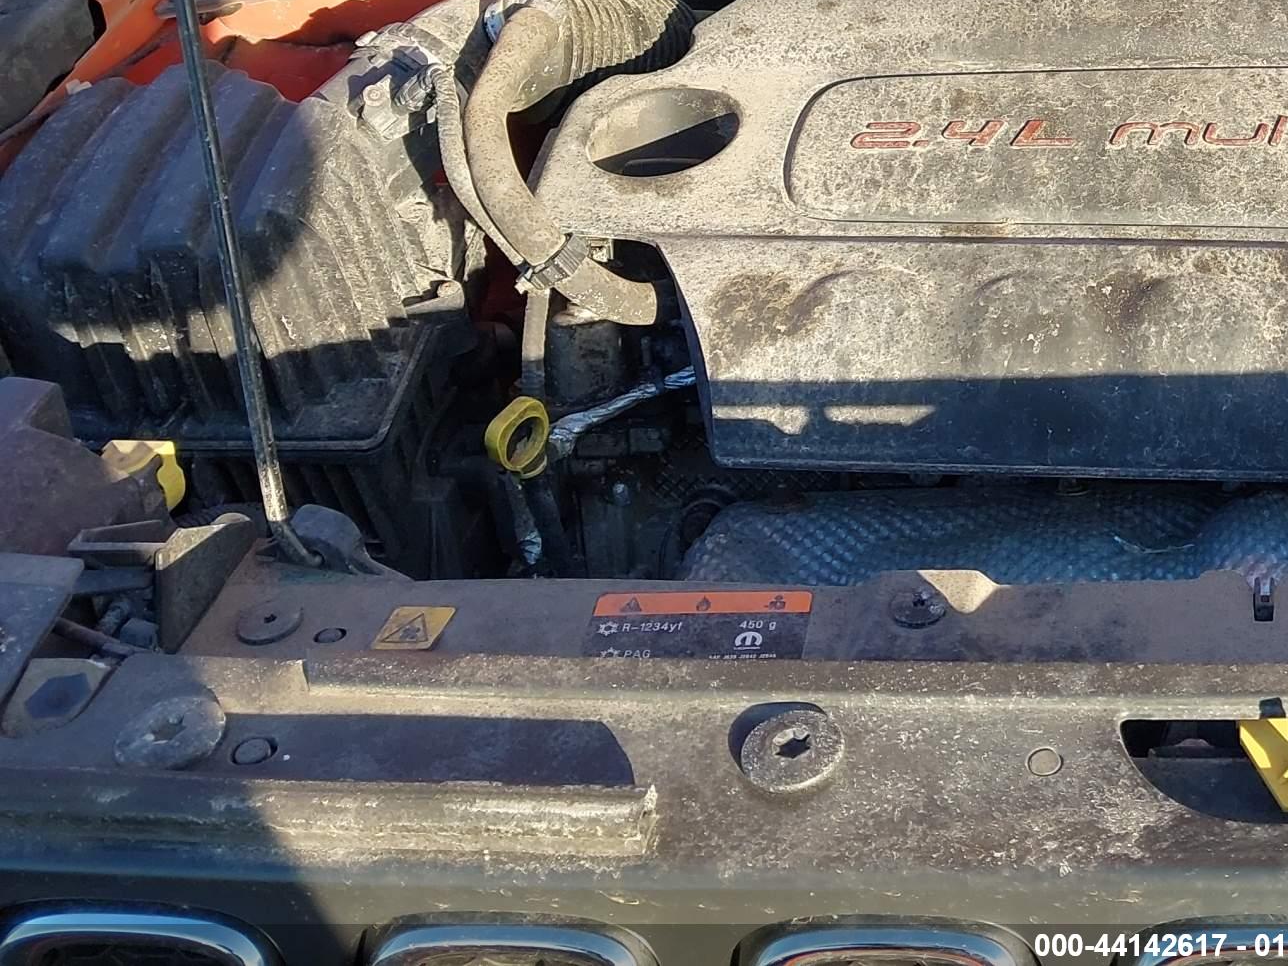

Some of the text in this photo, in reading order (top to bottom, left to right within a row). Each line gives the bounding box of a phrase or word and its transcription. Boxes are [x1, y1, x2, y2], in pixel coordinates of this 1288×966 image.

[850, 119, 1073, 149] 2.4L
[739, 620, 764, 629] 450
[623, 649, 651, 659] PAG
